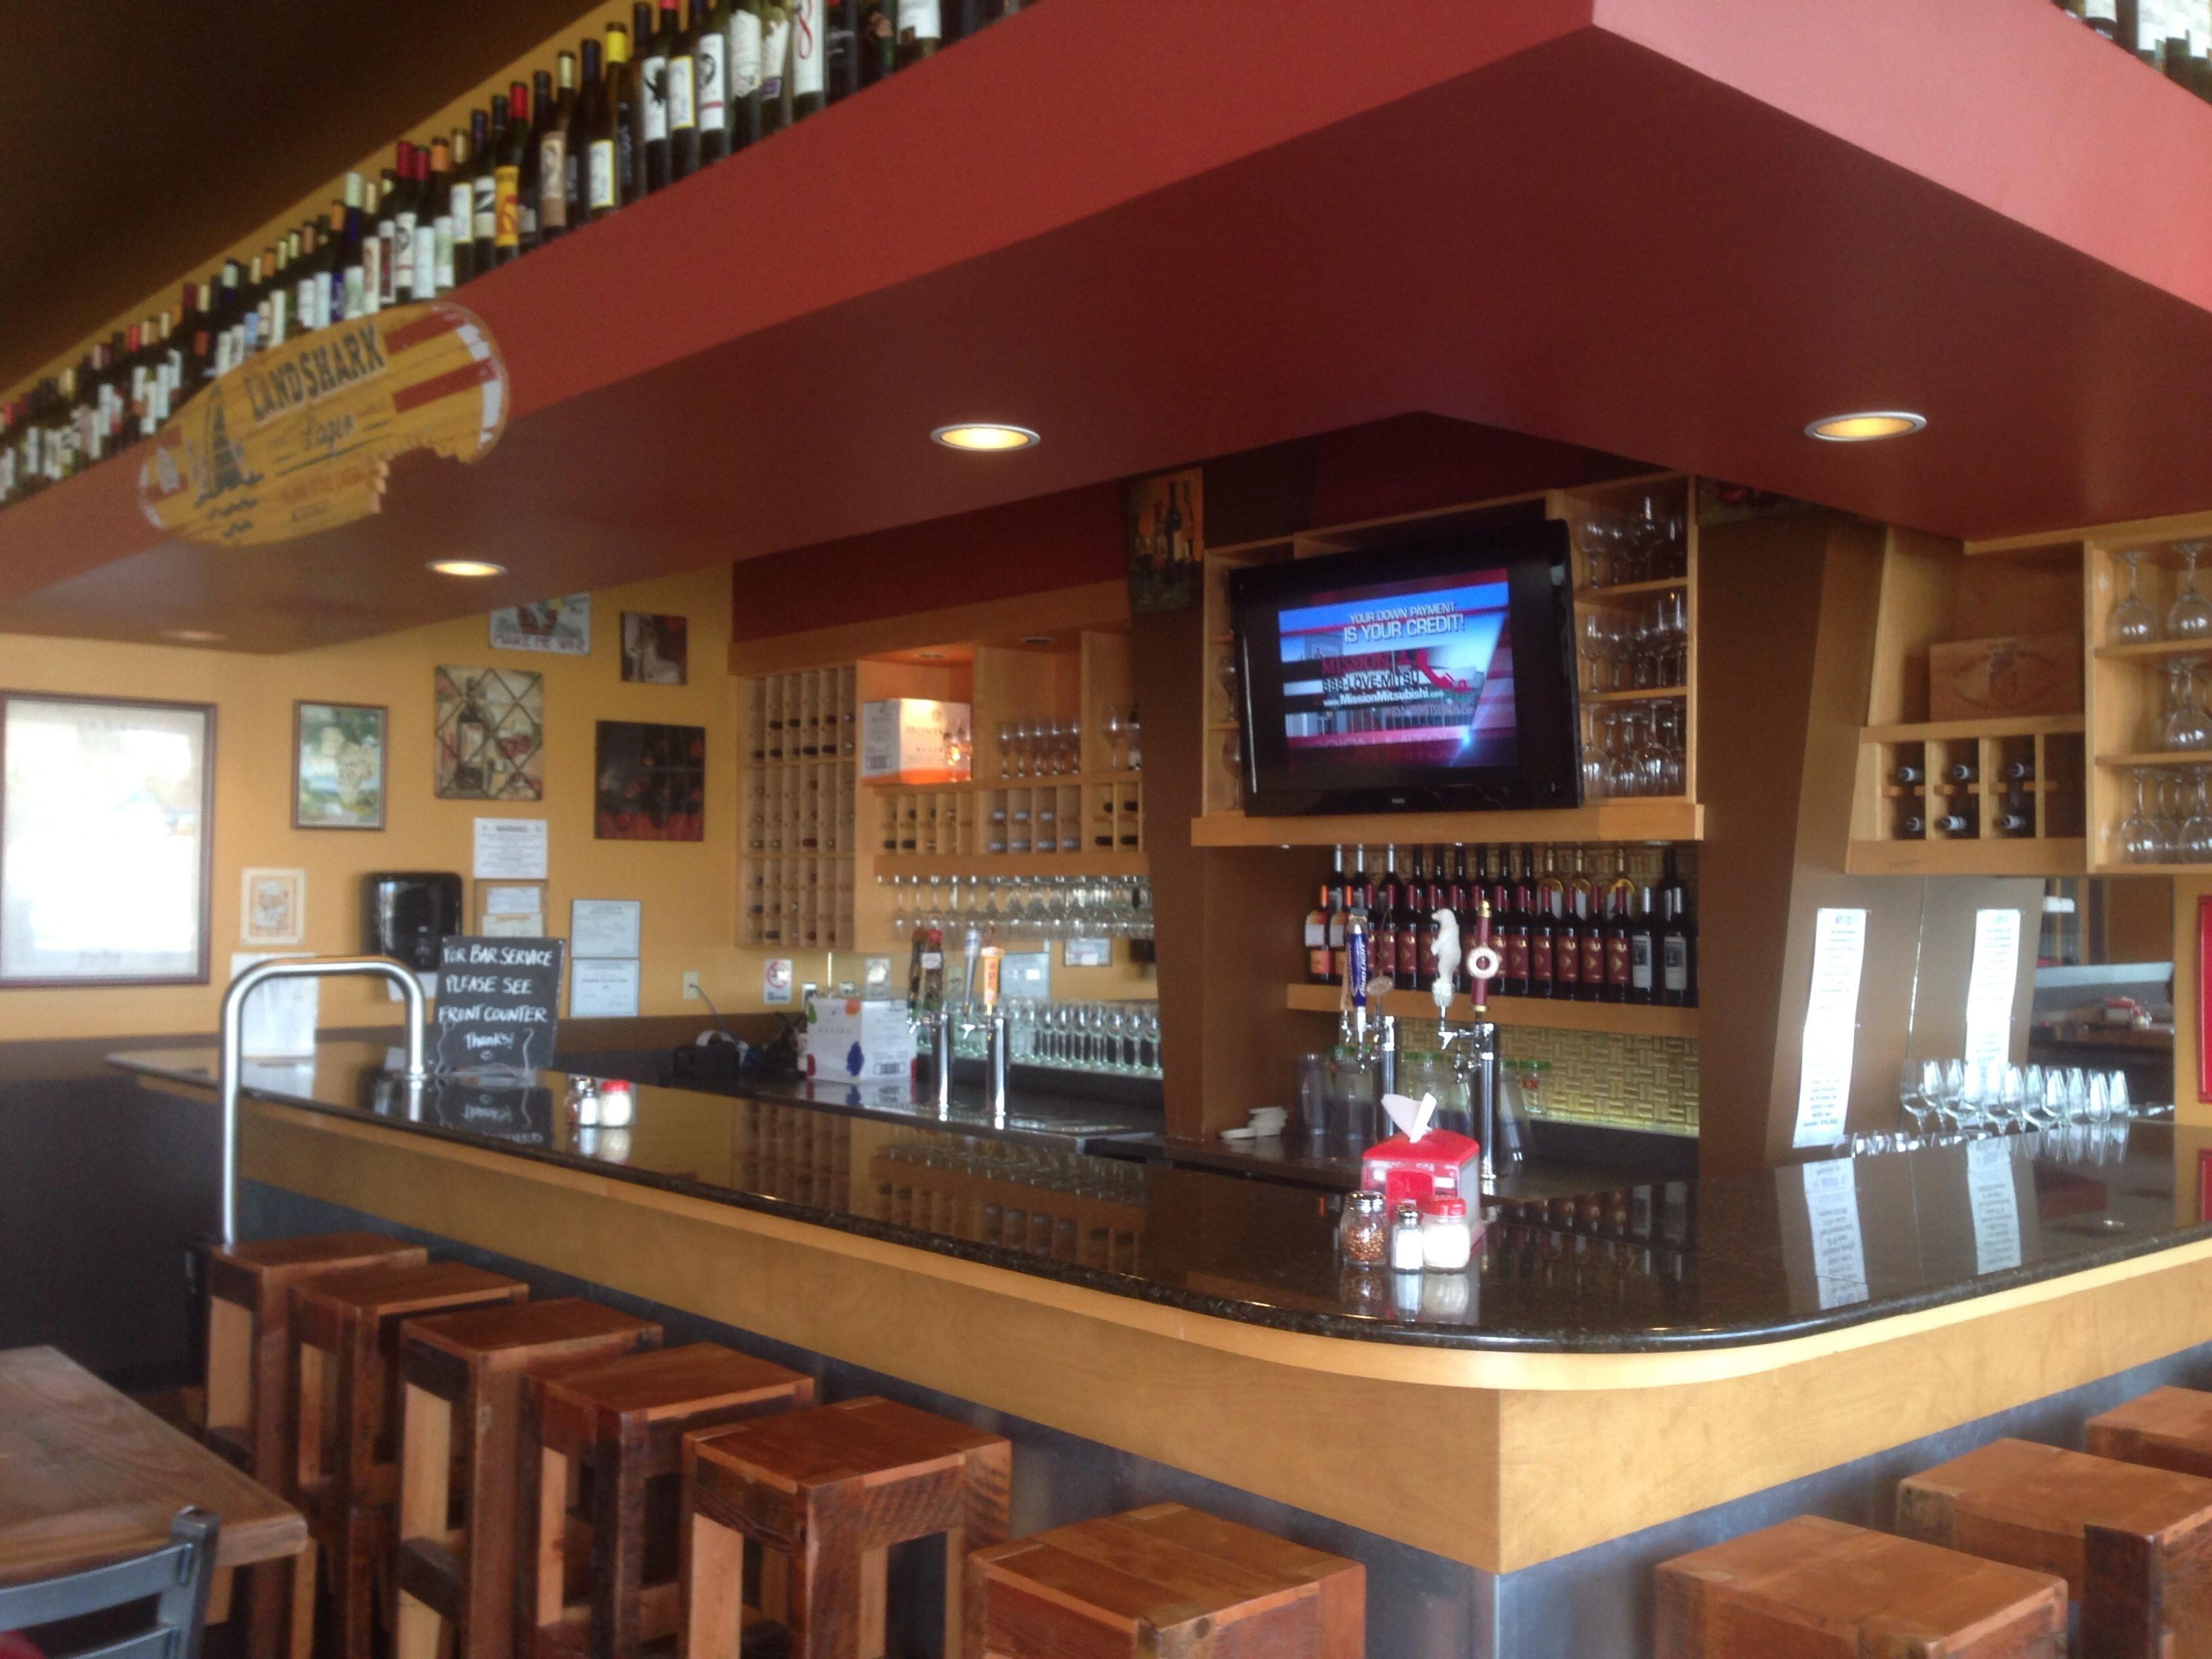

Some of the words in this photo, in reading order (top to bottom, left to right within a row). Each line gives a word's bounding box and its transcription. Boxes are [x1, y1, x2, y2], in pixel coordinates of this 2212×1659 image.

[245, 323, 386, 422] LANDSHARK
[1350, 612, 1374, 623] YOUR
[1378, 608, 1408, 620] DOWN
[1410, 602, 1456, 617] PAYMENT
[1344, 626, 1357, 642] IS
[1361, 620, 1401, 640] YOUR
[1406, 613, 1465, 637] CREDIT!
[443, 947, 466, 963] FOR
[470, 943, 498, 964] BAR
[500, 946, 553, 967] SERVICE
[445, 974, 497, 994] PLEASE
[503, 977, 533, 994] SEE
[438, 1004, 485, 1024] FRONT
[484, 1004, 548, 1023] COUNTER
